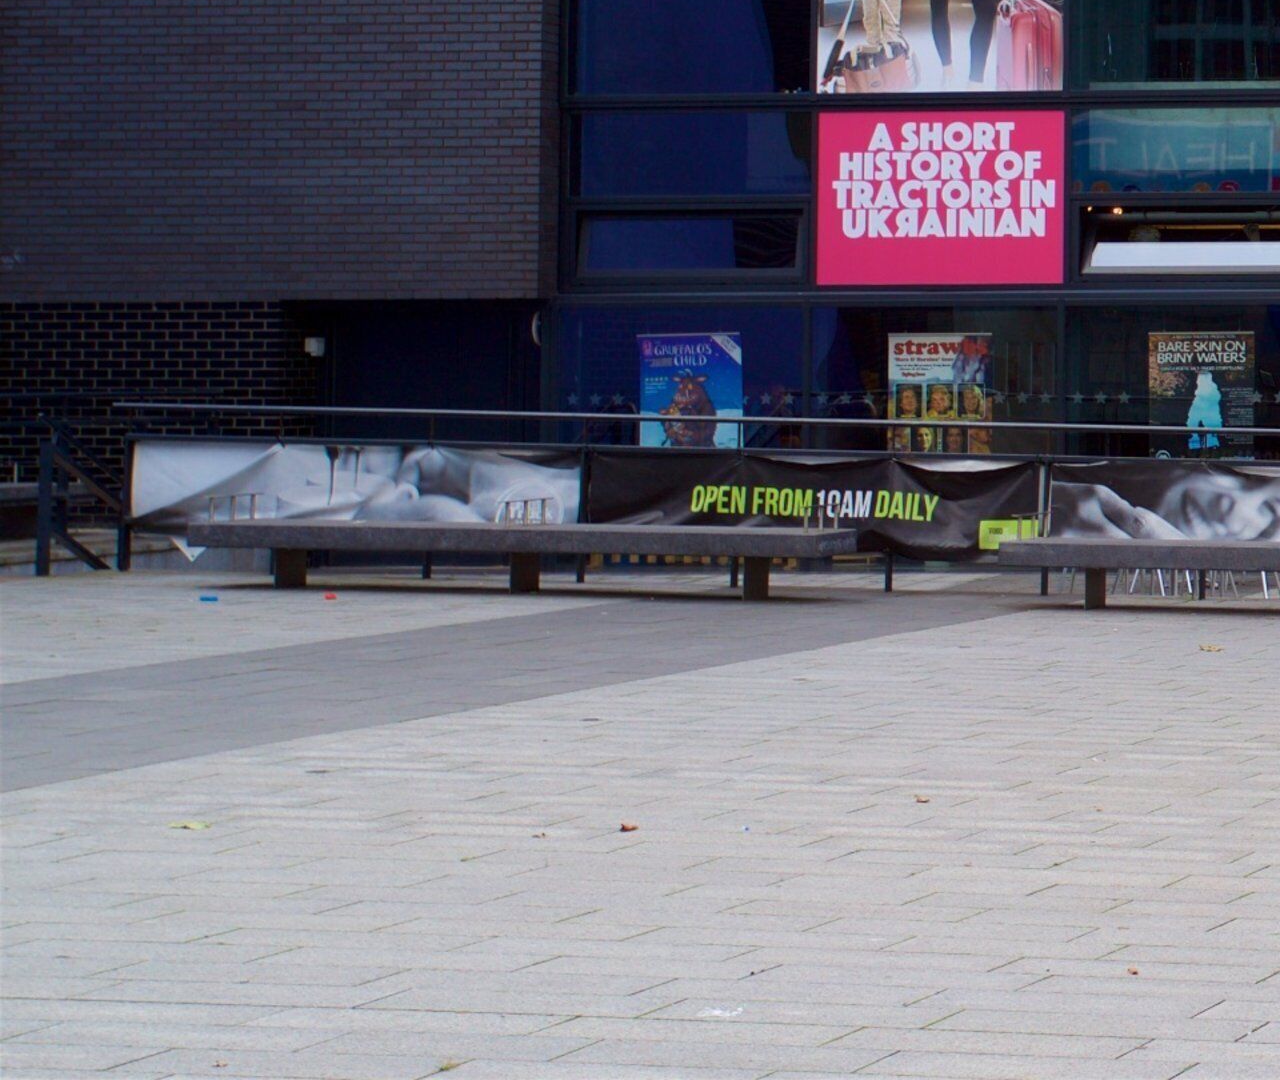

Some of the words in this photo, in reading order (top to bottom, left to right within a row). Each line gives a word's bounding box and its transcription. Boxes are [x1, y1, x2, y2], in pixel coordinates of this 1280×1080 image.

[867, 123, 894, 151] A
[901, 122, 1015, 151] SHORT
[839, 151, 987, 180] HISTORY
[994, 151, 1041, 179] OF
[832, 180, 1011, 209] TRACTORS
[1020, 179, 1055, 208] IN
[1157, 341, 1190, 352] BARE
[1193, 340, 1222, 352] SKIN
[1224, 340, 1246, 352] ON
[1157, 352, 1193, 363] BRINY
[1196, 352, 1246, 363] WATERS
[691, 485, 746, 515] OPEN
[752, 487, 813, 517] FROM
[816, 489, 873, 518] 10AM
[874, 490, 940, 522] DAILY
